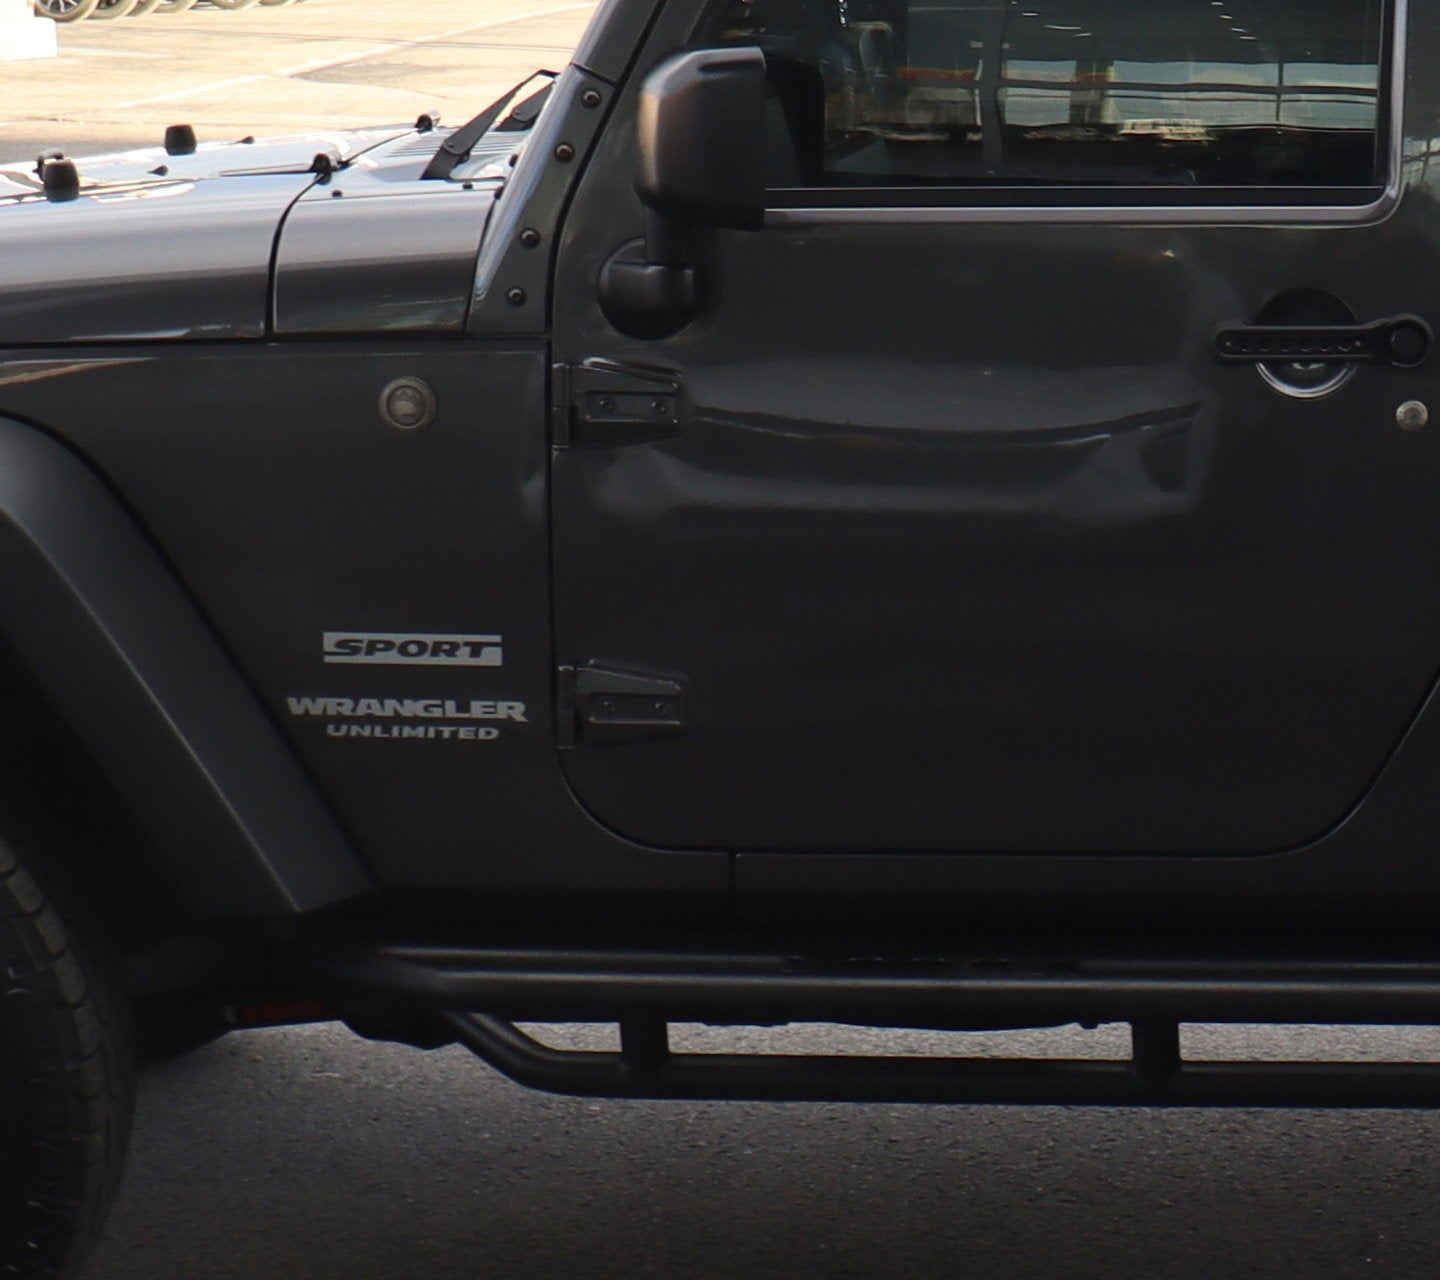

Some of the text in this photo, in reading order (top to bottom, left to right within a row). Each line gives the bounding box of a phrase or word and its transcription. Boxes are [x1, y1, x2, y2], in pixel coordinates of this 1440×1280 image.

[326, 637, 500, 660] SPORT
[286, 696, 529, 723] WRANGLER
[326, 723, 500, 741] UNLIMITED
